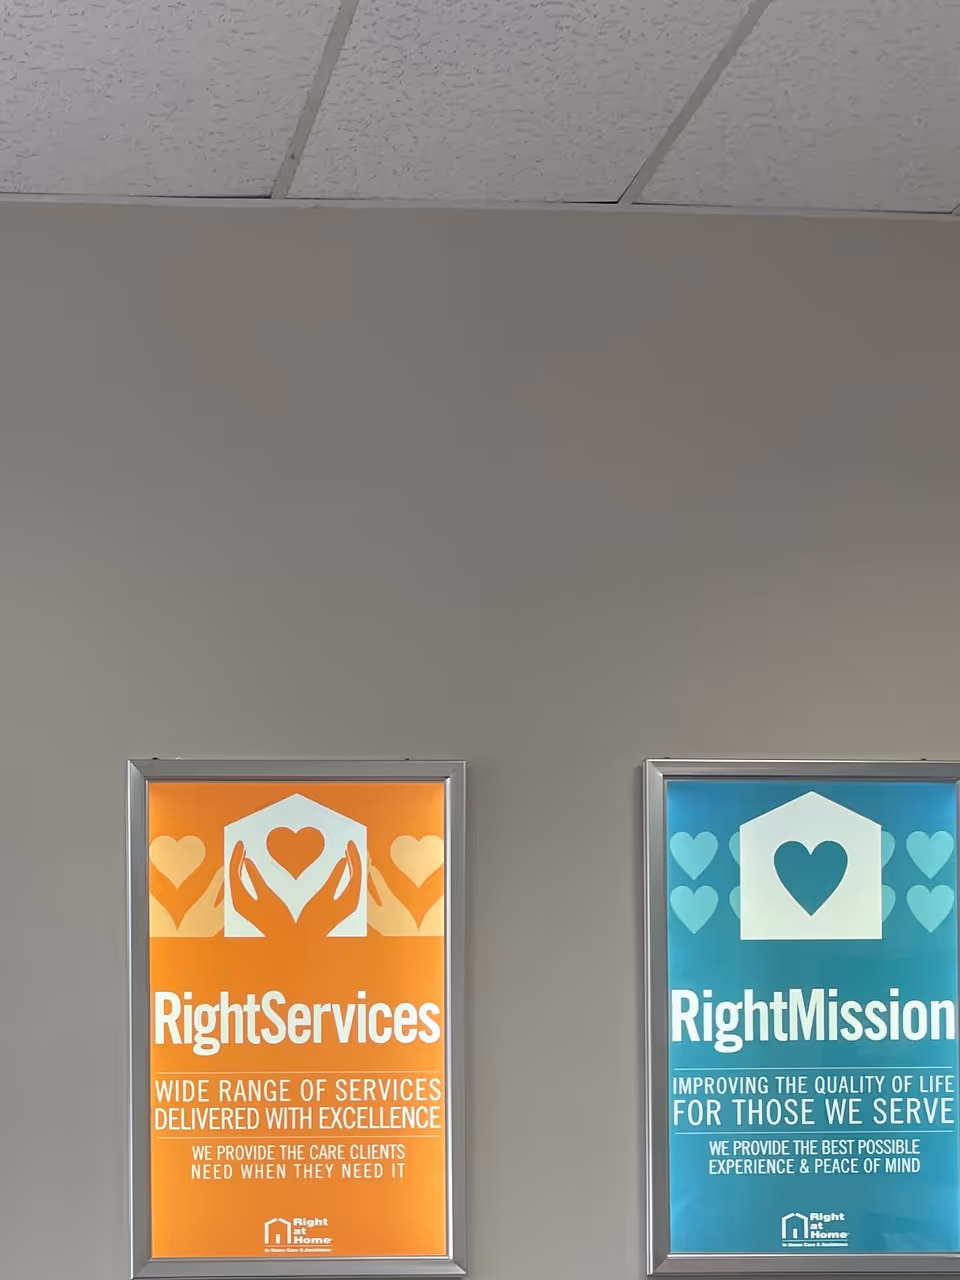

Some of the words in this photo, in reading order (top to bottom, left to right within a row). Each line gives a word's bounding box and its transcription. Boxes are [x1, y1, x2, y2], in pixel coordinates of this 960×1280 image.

[154, 990, 441, 1056] RightServices
[671, 987, 956, 1054] RightMission
[155, 1079, 210, 1102] WIDE
[219, 1079, 291, 1102] RANGE
[300, 1078, 327, 1101] OF
[335, 1078, 442, 1101] SERVICES
[672, 1076, 769, 1095] IMPROVING
[775, 1076, 808, 1094] THE
[814, 1075, 886, 1095] QUALITY
[891, 1075, 913, 1093] OF
[919, 1075, 955, 1093] LIFE
[155, 1107, 260, 1130] DELIVERED
[265, 1106, 313, 1130] WITH
[319, 1105, 442, 1129] EXCELLENCE
[673, 1098, 722, 1126] FOR
[731, 1098, 815, 1126] THOSE
[824, 1098, 863, 1125] WE
[872, 1097, 955, 1125] SERVE
[191, 1145, 213, 1161] WE
[216, 1145, 276, 1161] PROVIDE
[279, 1145, 305, 1161] THE
[309, 1145, 345, 1161] CARE
[350, 1144, 405, 1160] CLIENTS
[709, 1140, 730, 1156] WE
[733, 1140, 789, 1156] PROVIDE
[792, 1140, 818, 1155] THE
[822, 1139, 857, 1155] BEST
[858, 1139, 921, 1155] POSSIBLE
[191, 1164, 233, 1180] NEED
[240, 1164, 286, 1180] WHEN
[293, 1164, 334, 1180] THEY
[341, 1163, 383, 1179] NEED
[391, 1163, 406, 1179] IT
[709, 1158, 795, 1175] EXPERIENCE
[799, 1158, 810, 1175] &
[814, 1158, 859, 1174] PEACE
[863, 1157, 881, 1174] OF
[885, 1157, 921, 1173] MIND
[293, 1217, 329, 1228] Right
[809, 1212, 845, 1223] Right
[809, 1222, 824, 1230] at
[293, 1227, 307, 1235] at
[810, 1230, 849, 1239] Home
[293, 1236, 332, 1244] Home
